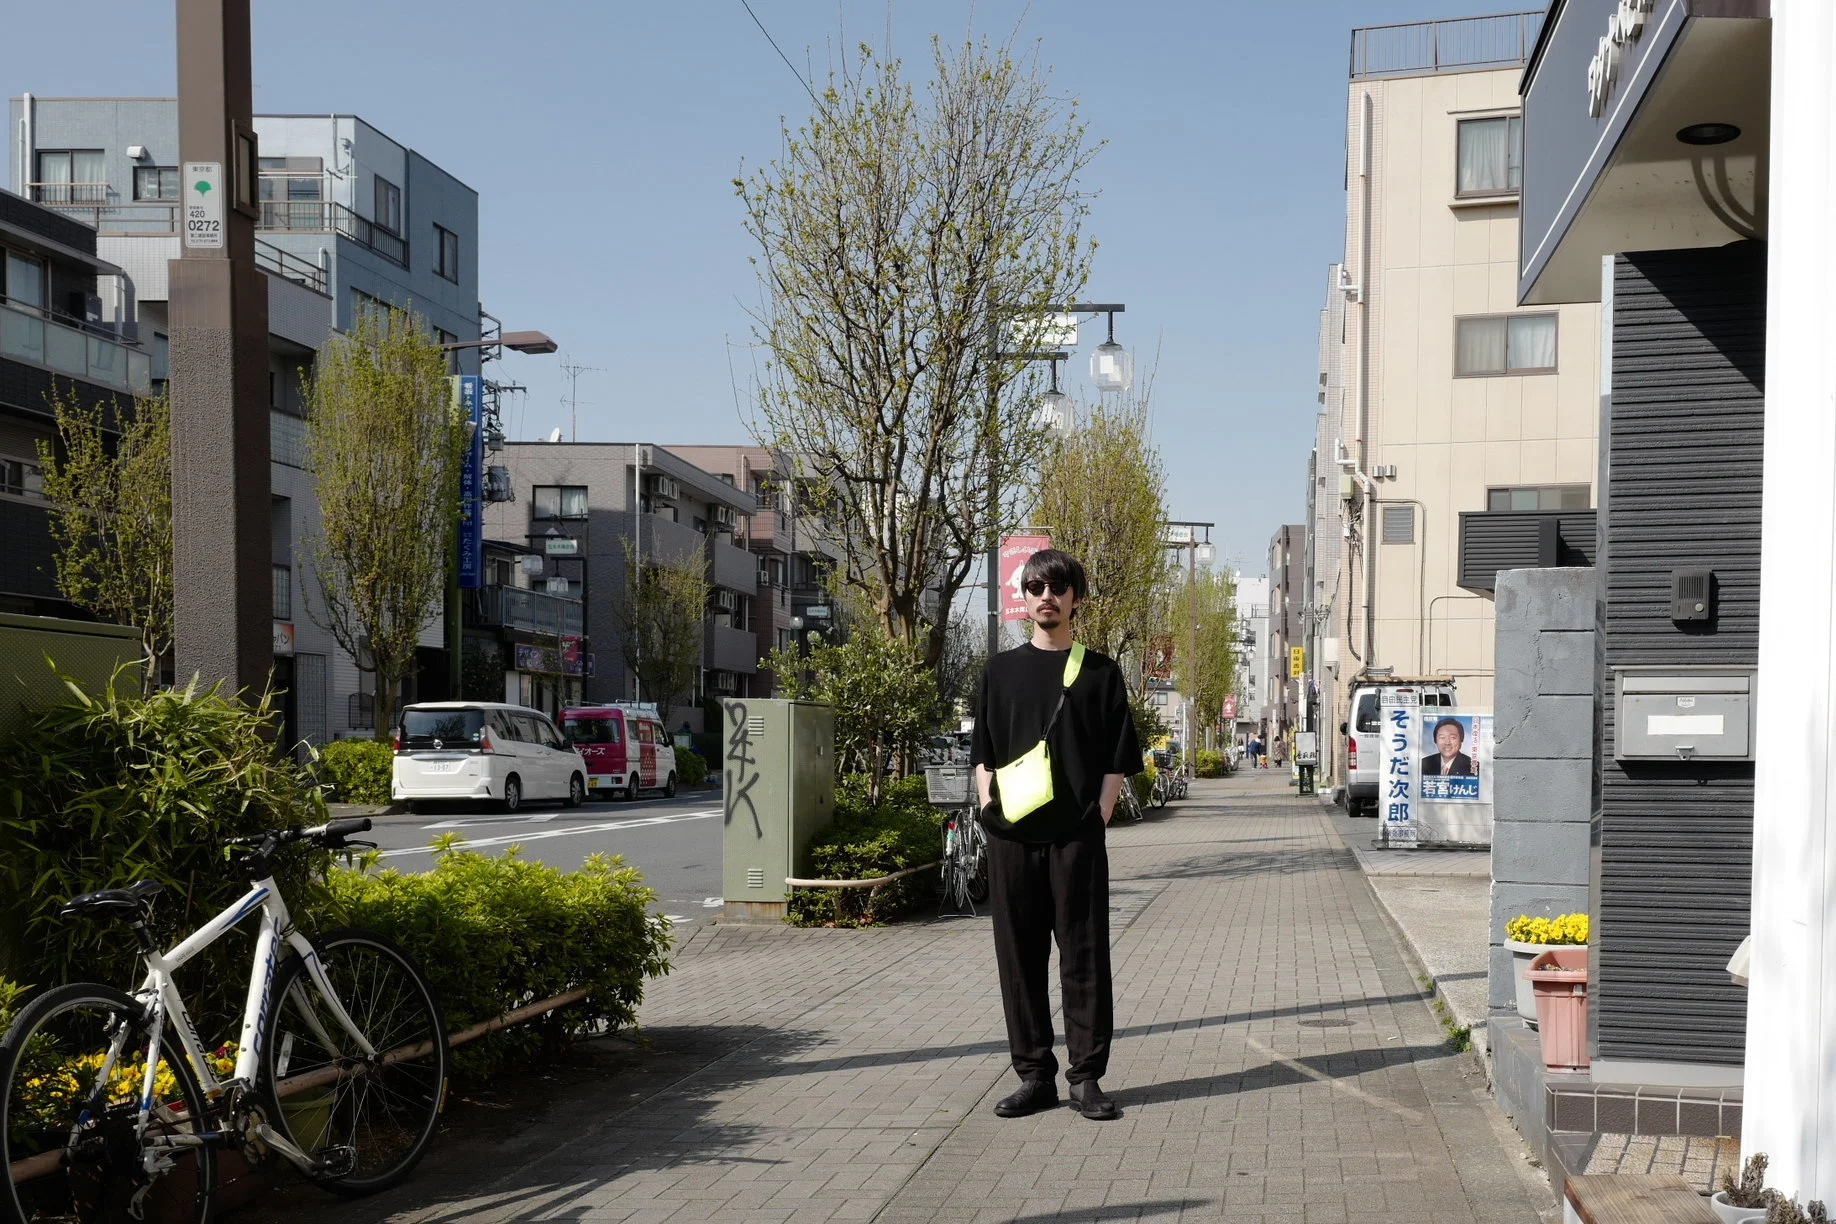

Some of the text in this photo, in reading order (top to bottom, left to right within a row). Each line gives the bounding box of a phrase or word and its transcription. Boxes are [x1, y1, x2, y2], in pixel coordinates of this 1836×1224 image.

[188, 220, 219, 231] 0272
[1382, 695, 1418, 704] 自由民主党
[1388, 710, 1410, 822] そうだ次郎
[1422, 780, 1478, 796] 若宮けんじ
